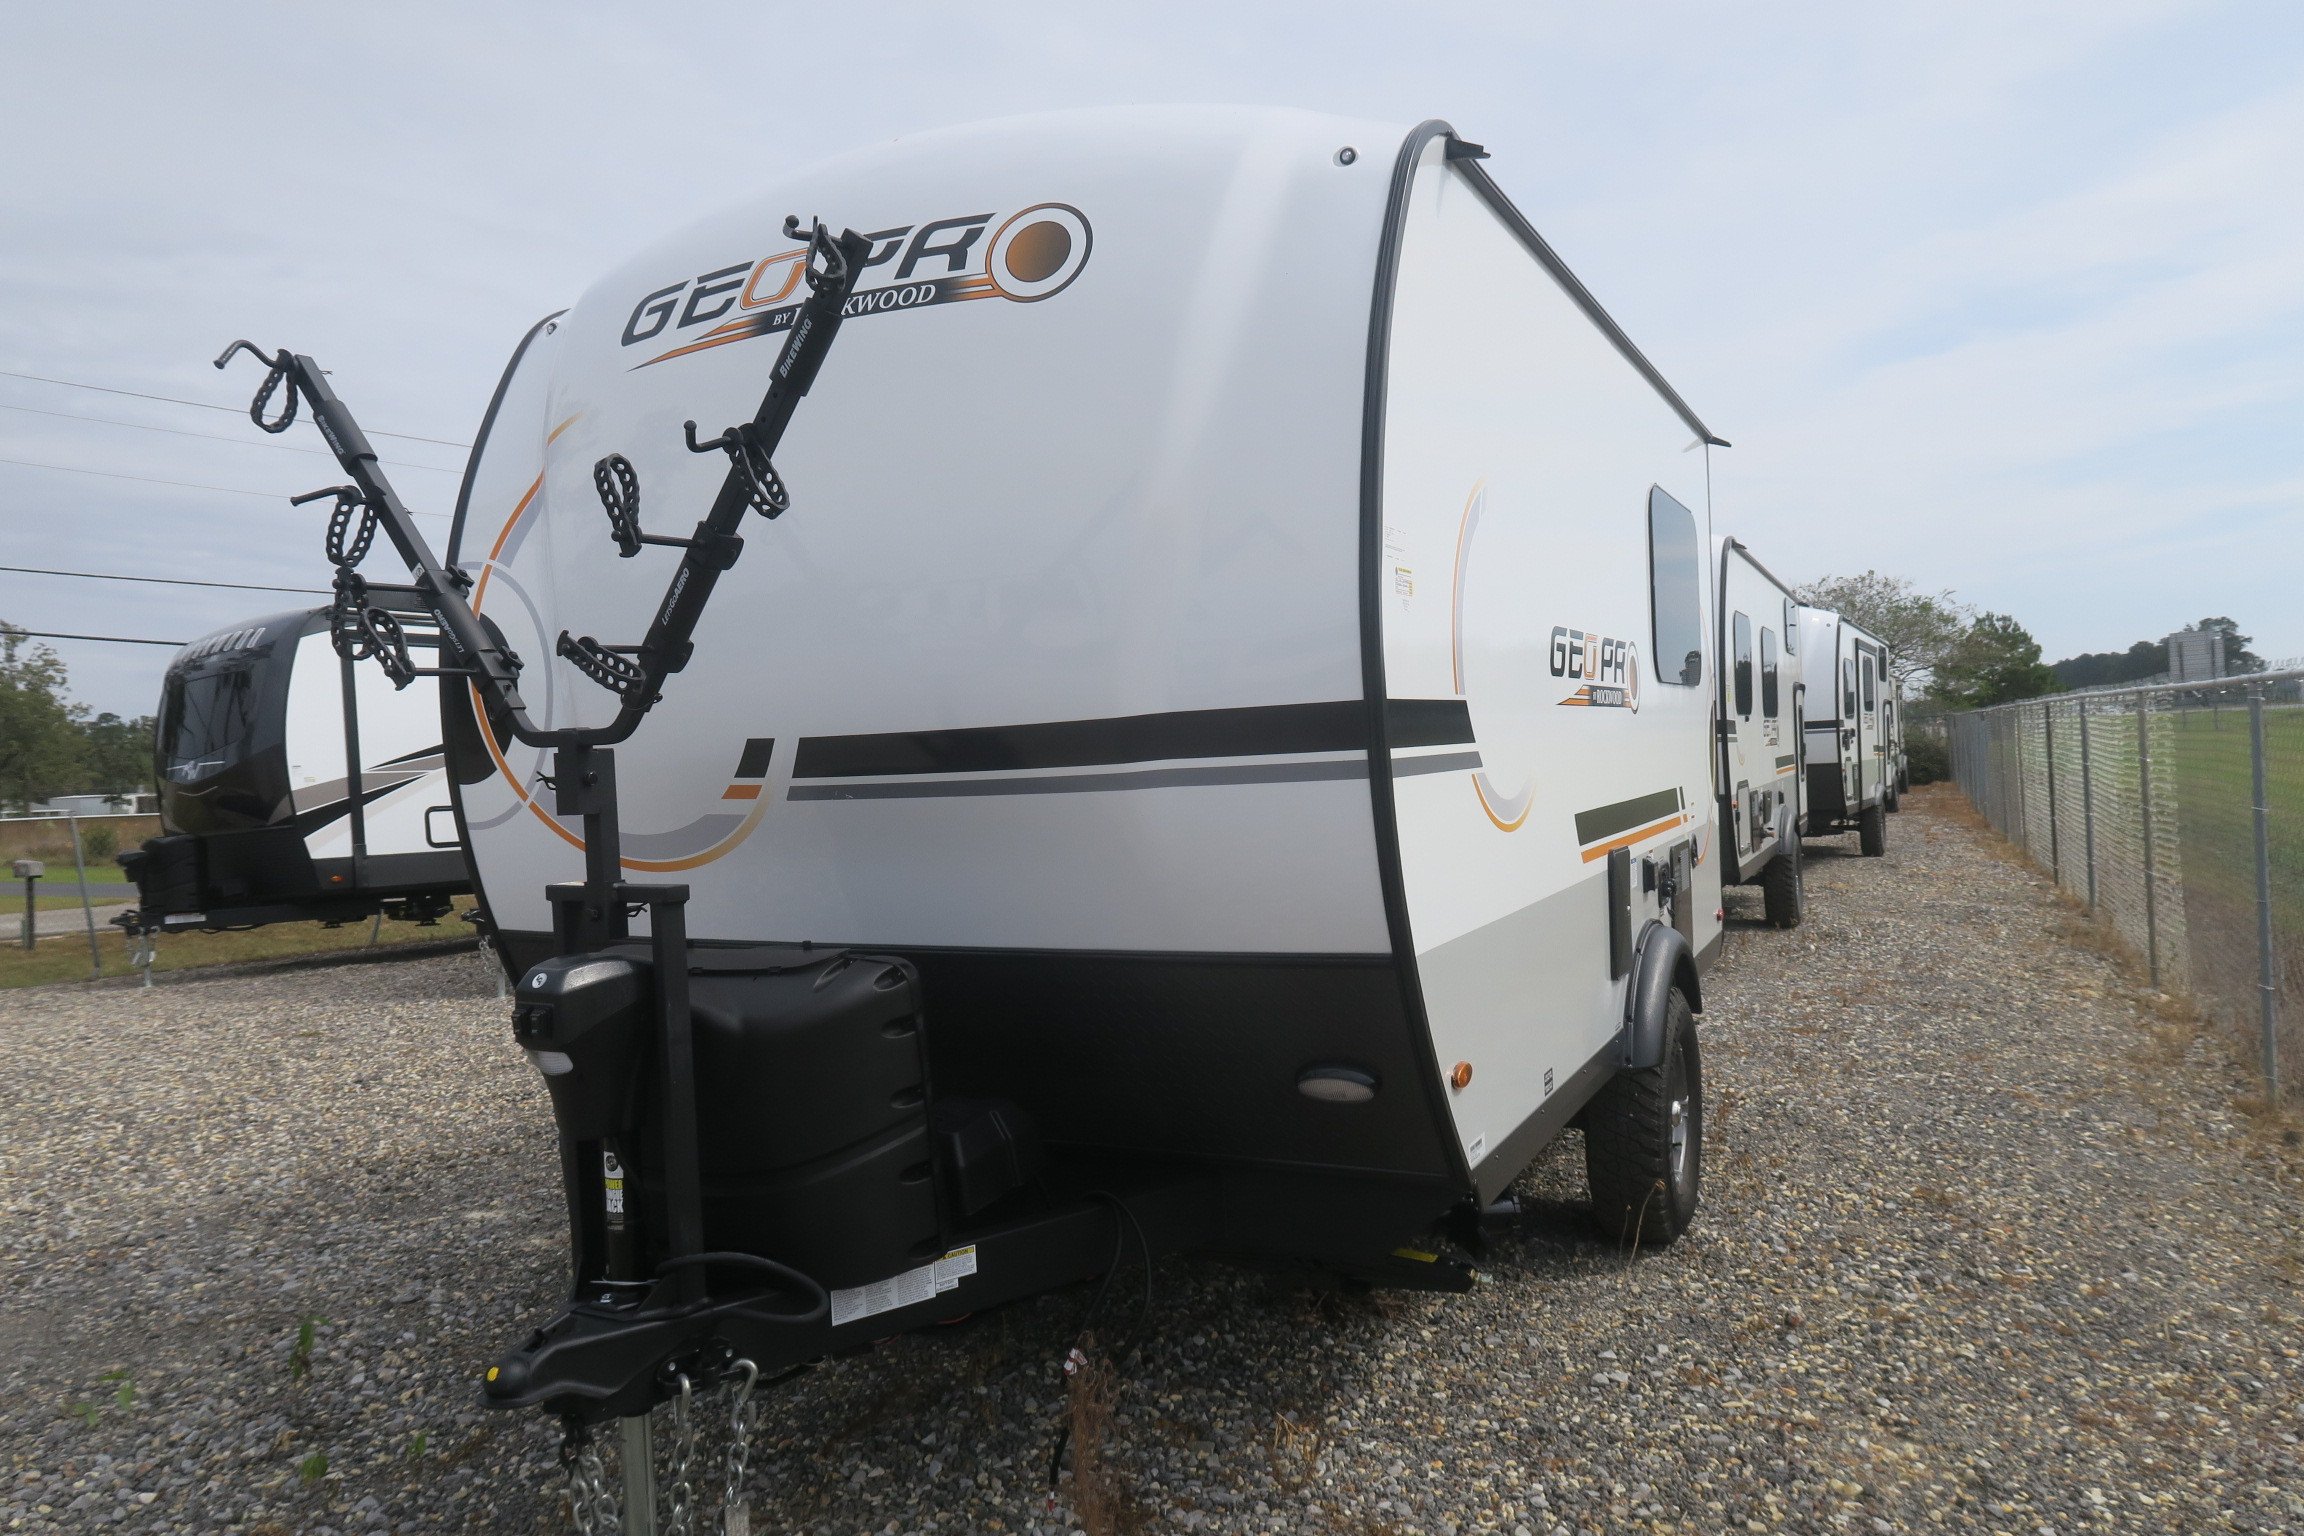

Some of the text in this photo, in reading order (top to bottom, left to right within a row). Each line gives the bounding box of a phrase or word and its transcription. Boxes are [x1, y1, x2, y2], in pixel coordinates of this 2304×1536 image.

[772, 284, 936, 326] BY KWOOD
[779, 318, 813, 379] BIKEWING
[317, 414, 344, 455] BIKEWING
